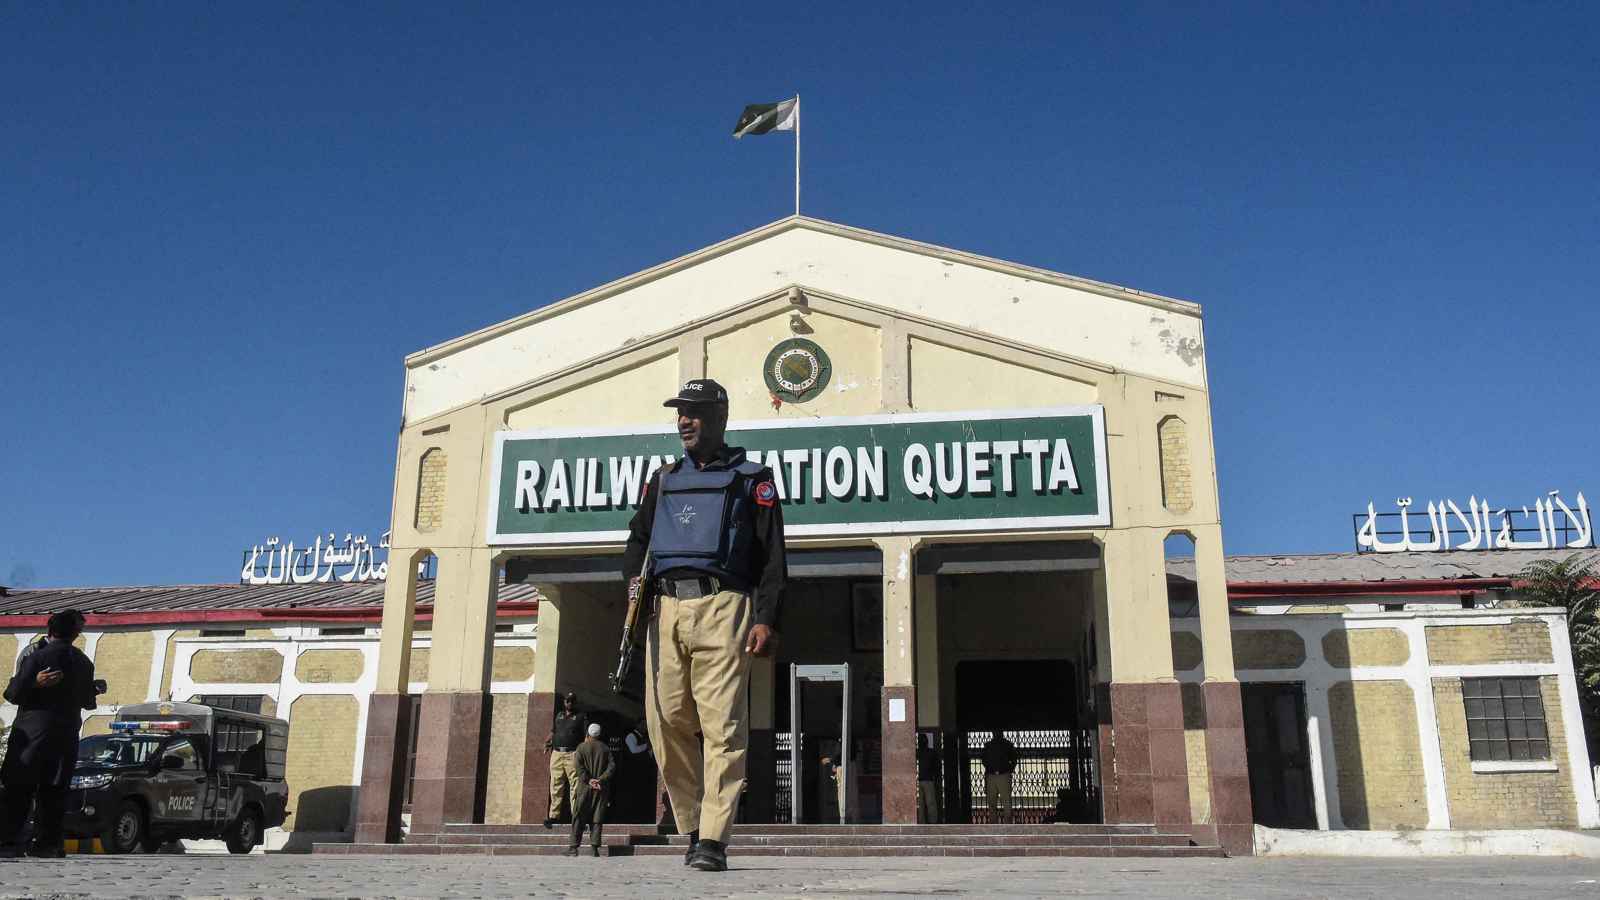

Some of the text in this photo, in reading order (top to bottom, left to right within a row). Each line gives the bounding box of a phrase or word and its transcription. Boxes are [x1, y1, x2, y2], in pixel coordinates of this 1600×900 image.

[514, 438, 1080, 509] RAILW ATION QUETTA
[168, 796, 195, 810] POLICE
